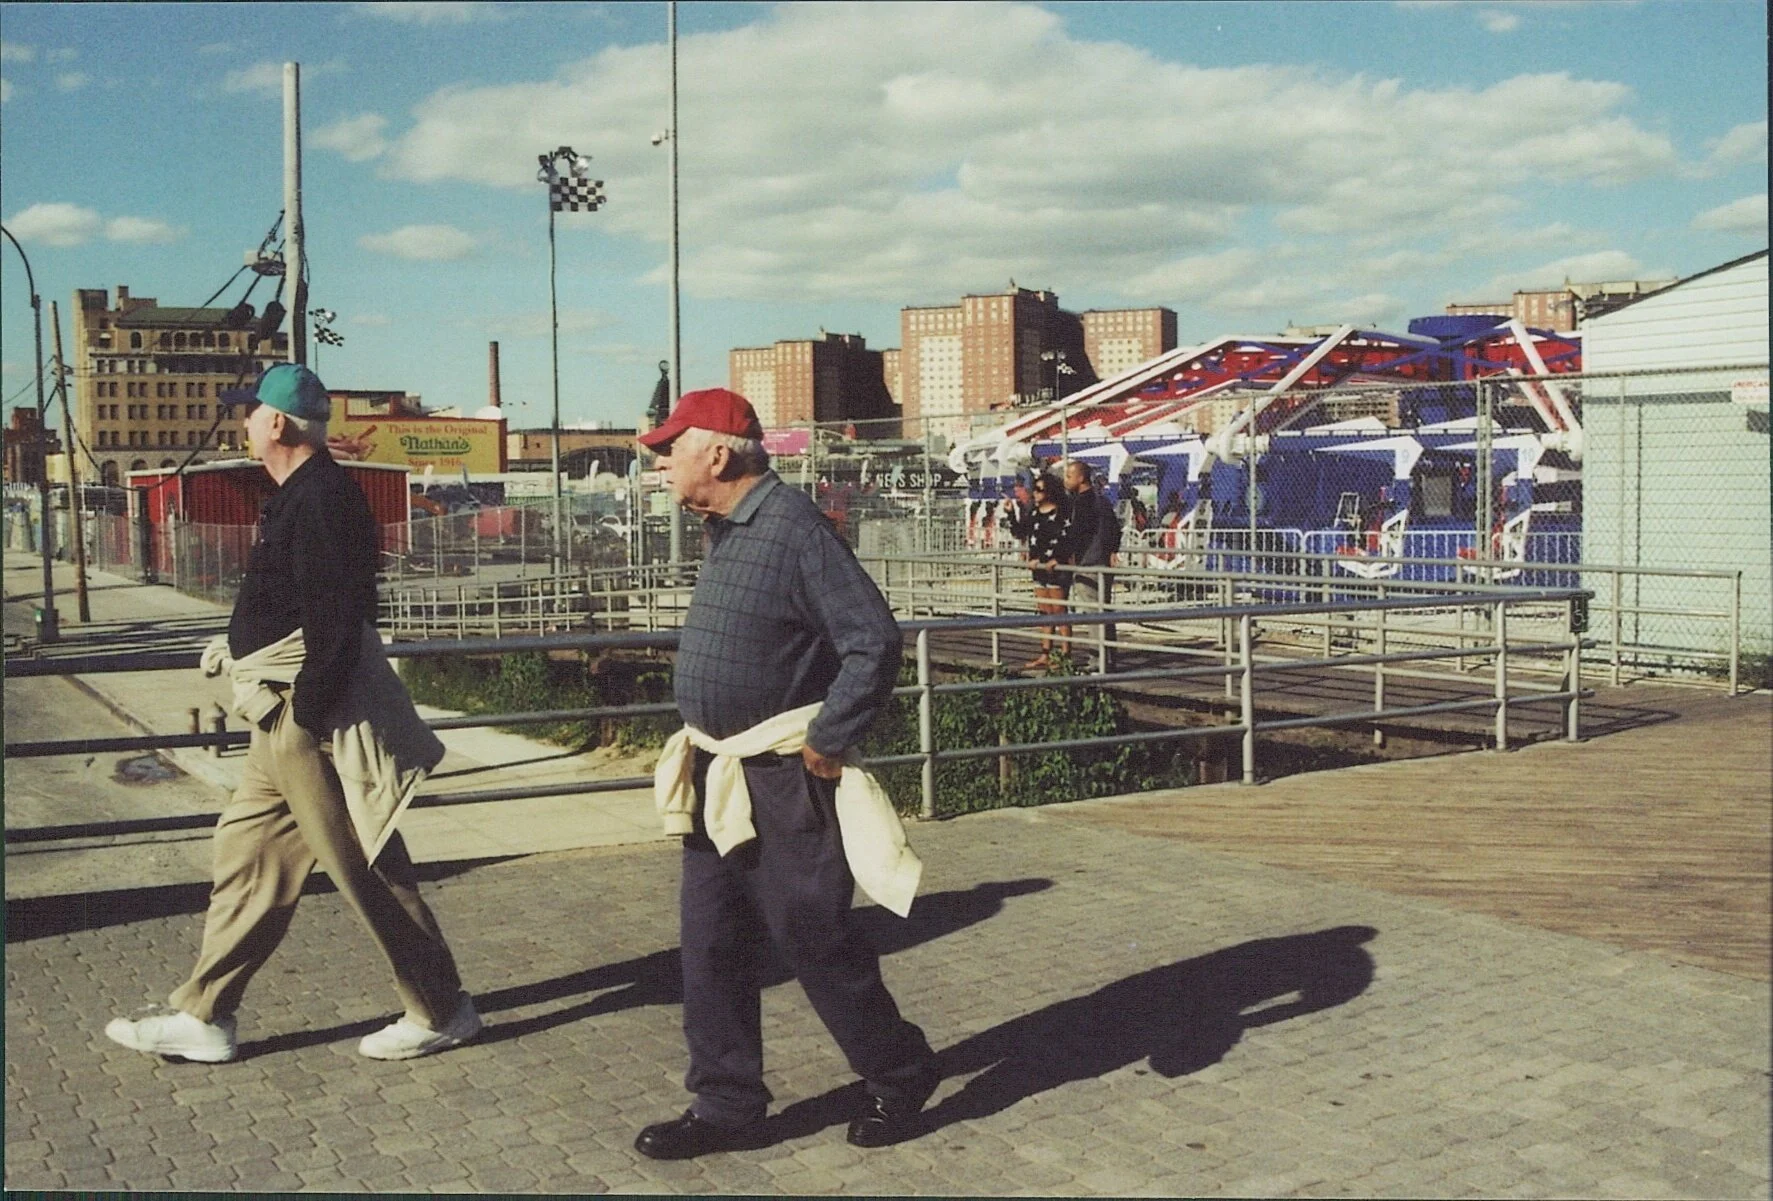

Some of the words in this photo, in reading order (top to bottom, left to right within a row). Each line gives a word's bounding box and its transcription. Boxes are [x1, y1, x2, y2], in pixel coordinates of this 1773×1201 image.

[388, 424, 411, 434] This
[413, 425, 422, 434] is
[426, 425, 442, 434] the
[444, 425, 487, 436] Original
[400, 435, 470, 451] Nathan's
[408, 457, 436, 467] Since
